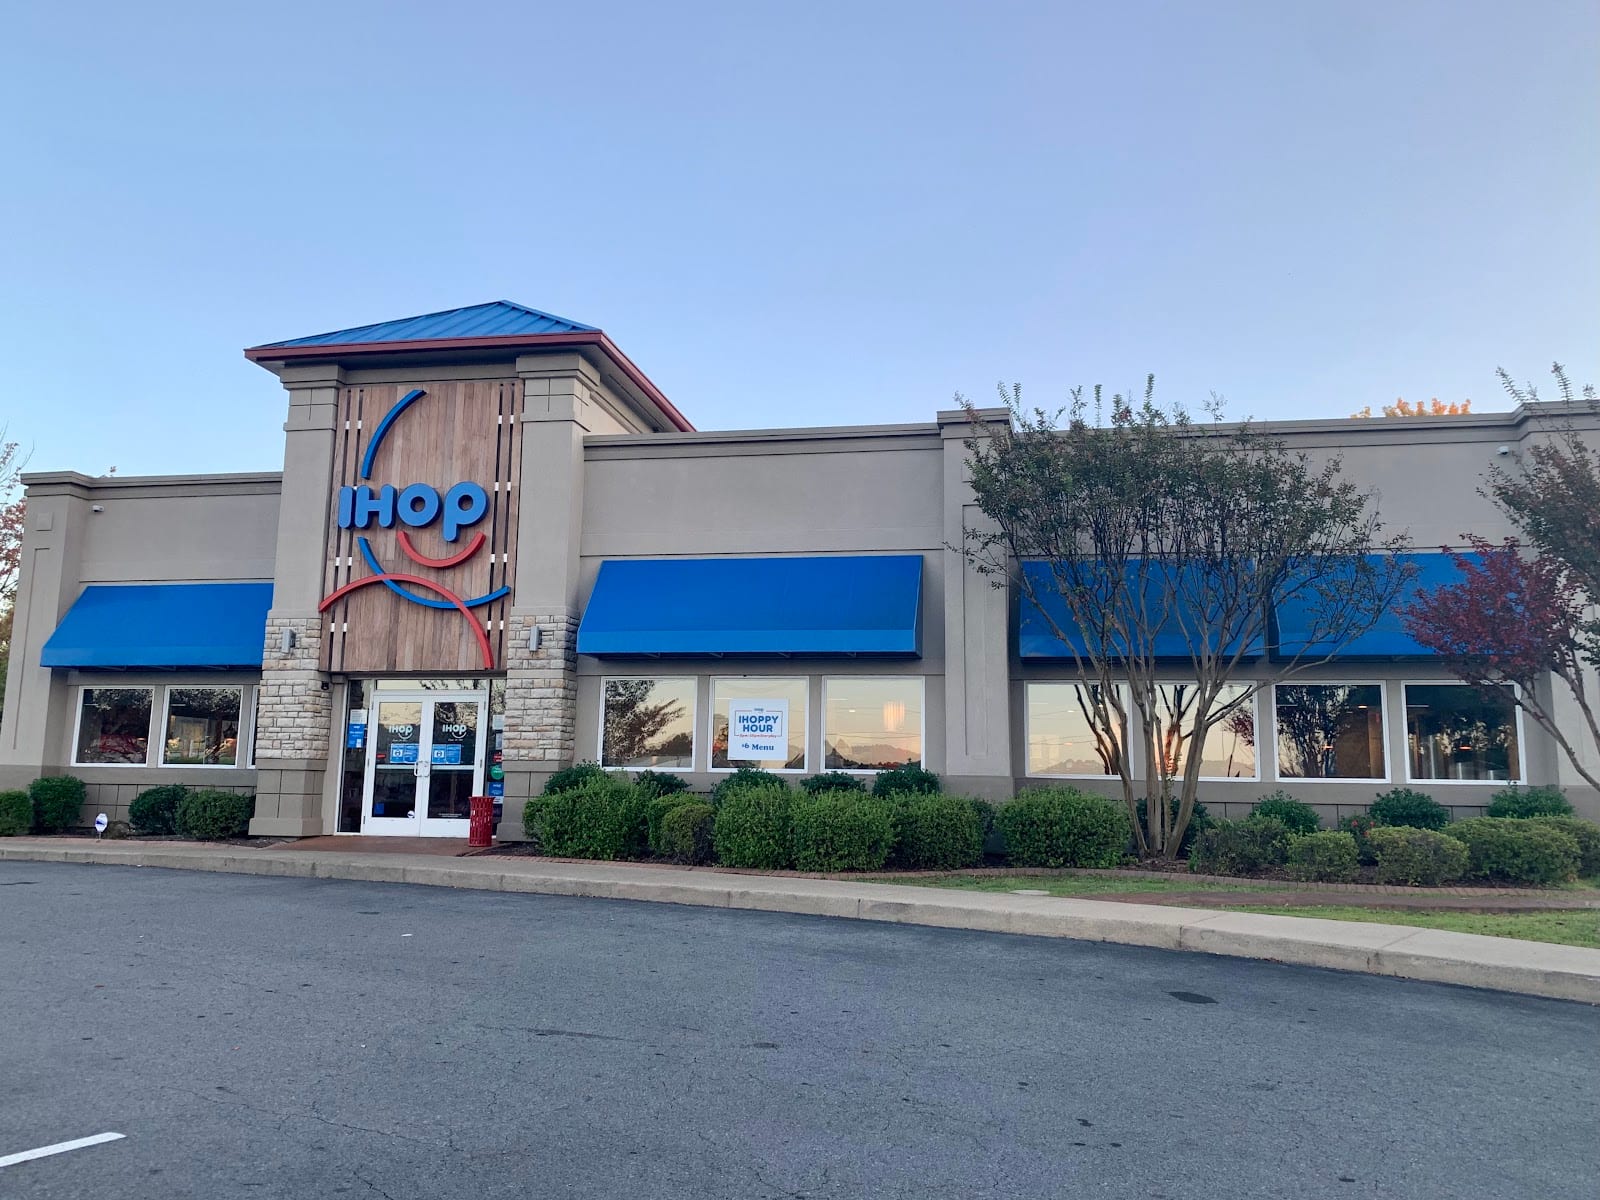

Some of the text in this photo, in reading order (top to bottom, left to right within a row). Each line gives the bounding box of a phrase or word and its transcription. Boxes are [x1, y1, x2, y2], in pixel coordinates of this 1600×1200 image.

[338, 481, 489, 542] IHOP
[739, 715, 778, 724] IHOPPY
[743, 724, 773, 732] HOUR
